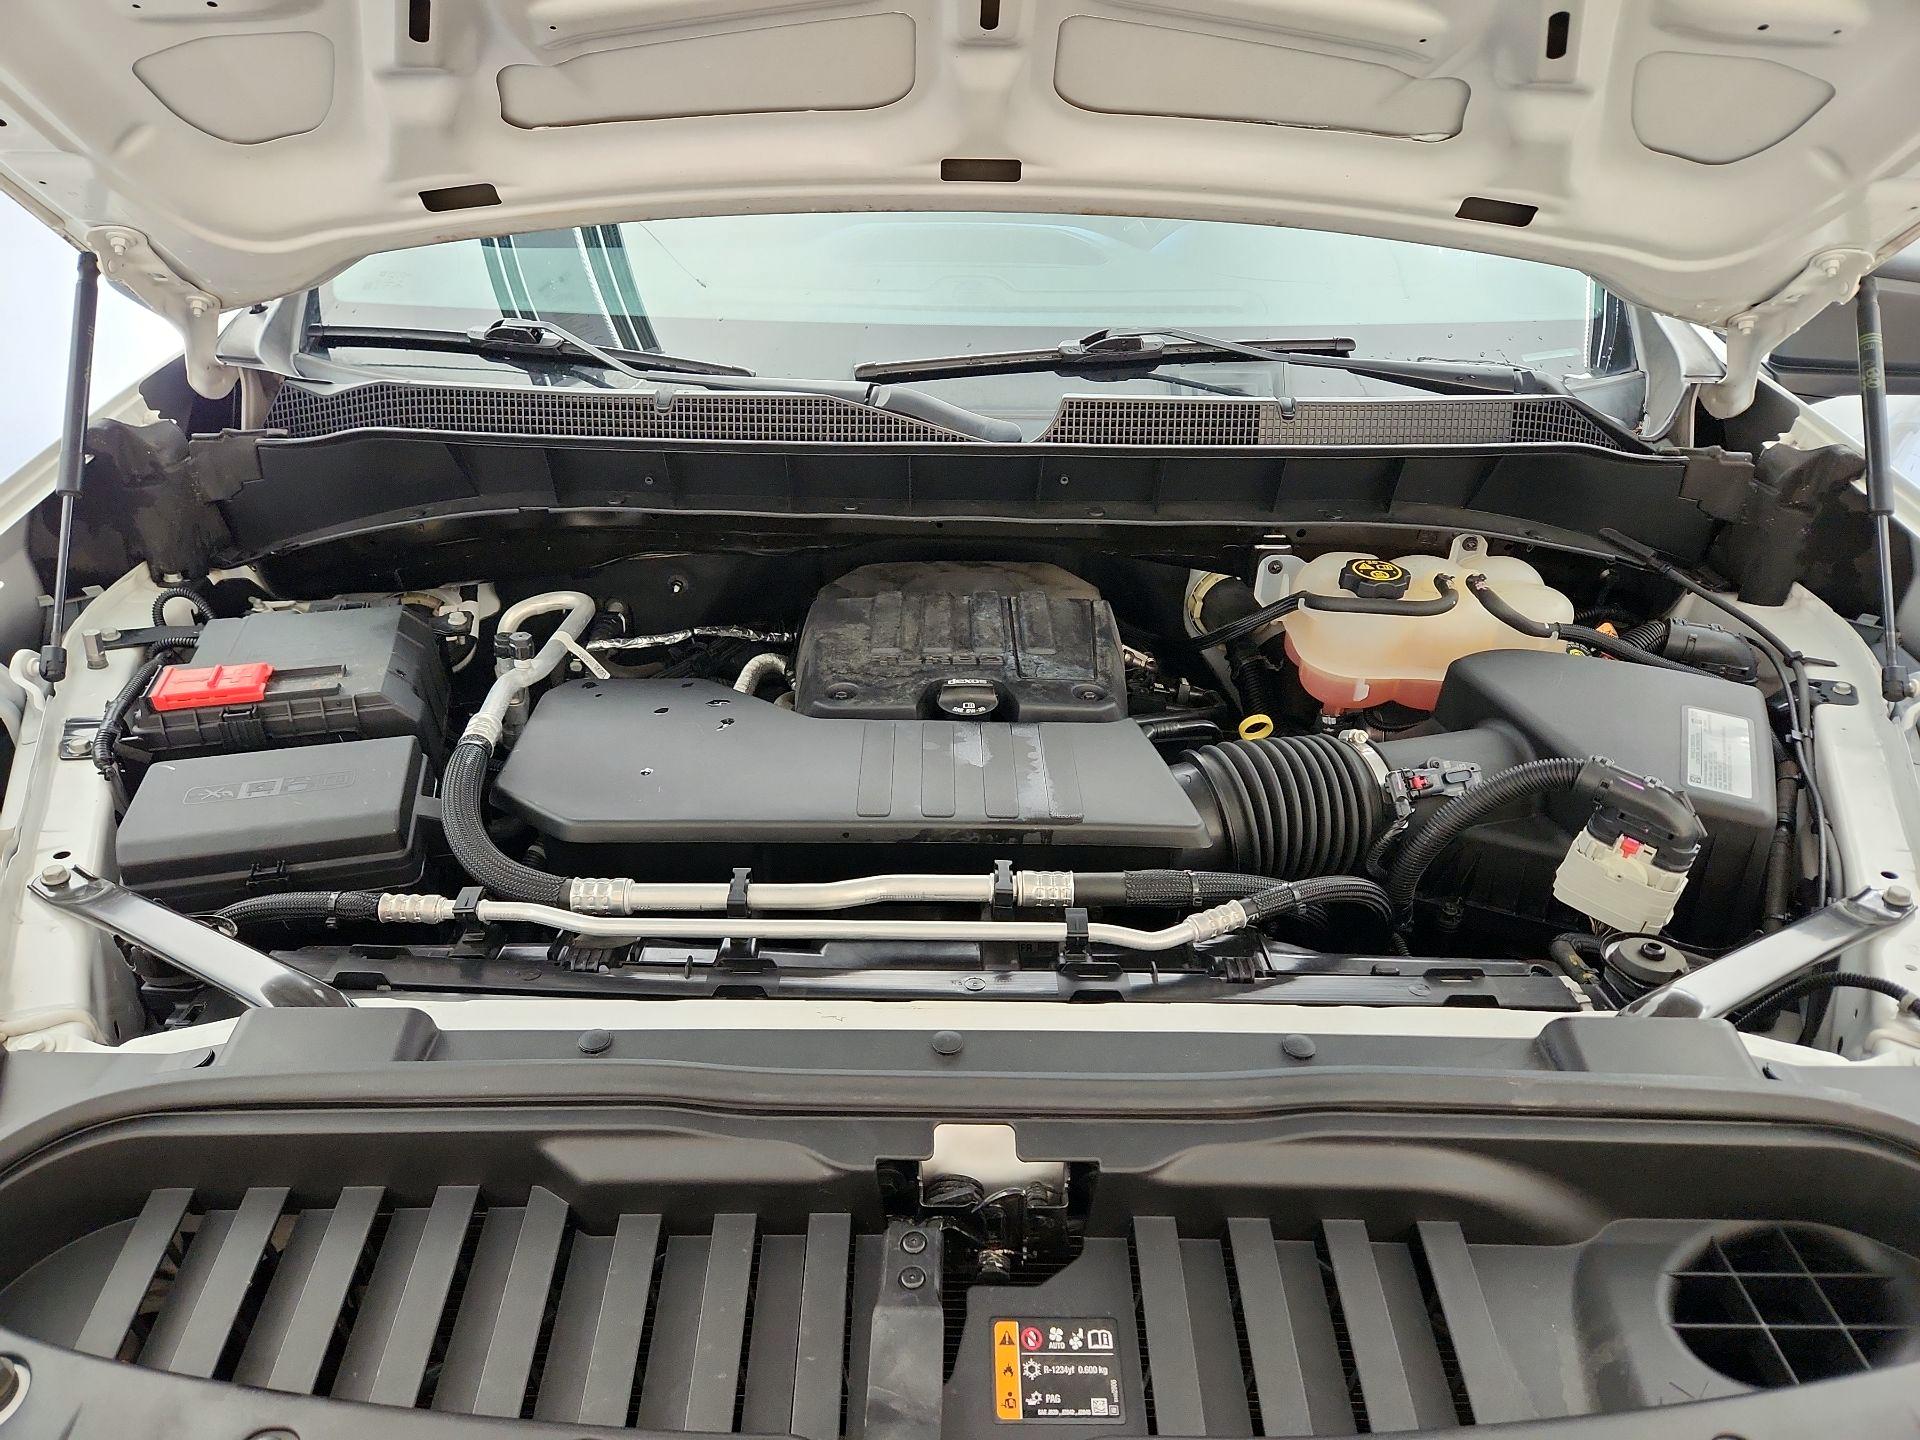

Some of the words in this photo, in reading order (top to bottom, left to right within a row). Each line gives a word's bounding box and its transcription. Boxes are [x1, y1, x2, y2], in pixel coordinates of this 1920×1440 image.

[1048, 1341, 1066, 1350] AUTO
[1043, 1365, 1075, 1376] R-1234yf
[1077, 1365, 1098, 1374] 0.600
[1098, 1365, 1109, 1376] kg
[1045, 1393, 1062, 1404] PAG
